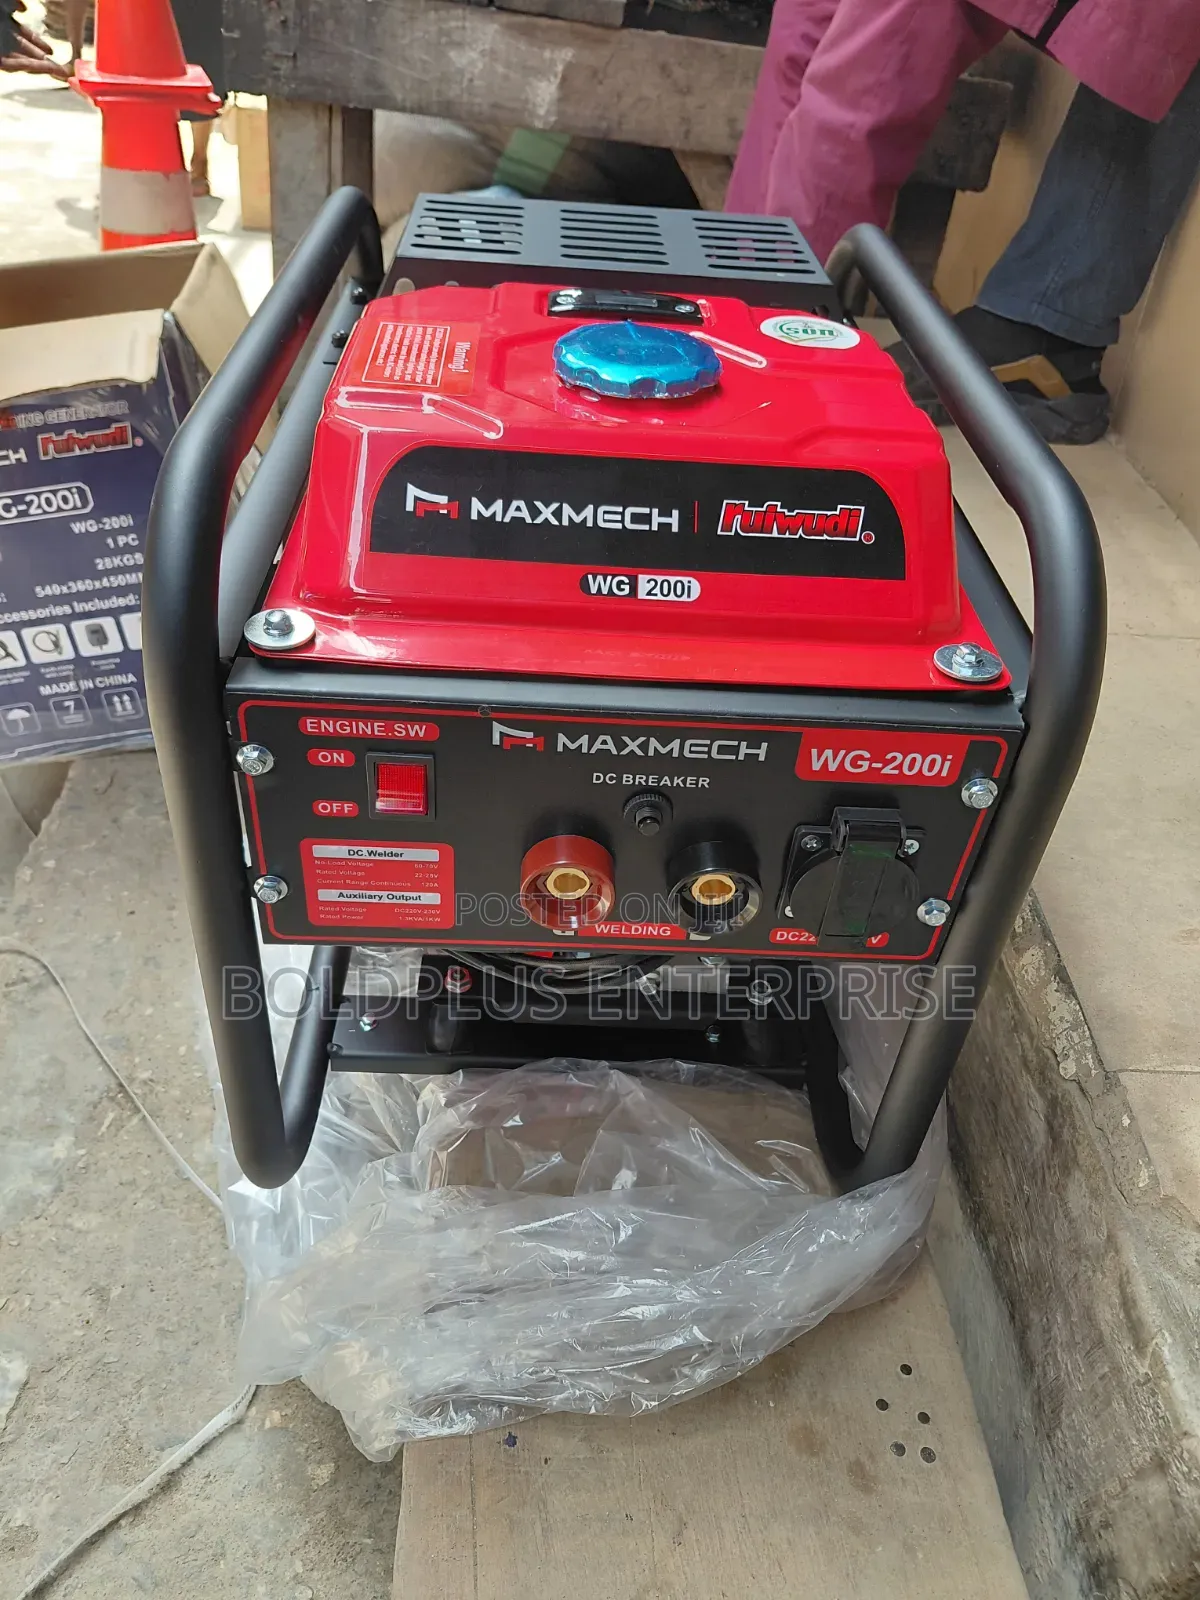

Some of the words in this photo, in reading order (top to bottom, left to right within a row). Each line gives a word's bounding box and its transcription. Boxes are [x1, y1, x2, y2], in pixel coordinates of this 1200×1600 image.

[471, 498, 679, 533] MAXMECH
[717, 499, 865, 539] ruiwudi
[105, 536, 115, 549] 1
[117, 534, 139, 547] PC
[586, 574, 631, 596] WG
[645, 576, 693, 600] 200i
[39, 681, 78, 696] MADE
[80, 679, 94, 690] IN
[96, 673, 137, 687] CHINA
[305, 718, 427, 738] ENGINE.SW
[556, 732, 769, 762] MAXMECH
[317, 751, 346, 764] ON
[810, 748, 954, 777] WG-200i
[592, 772, 617, 784] DC
[621, 774, 710, 788] BREAKER
[317, 802, 354, 814] OFF
[347, 848, 405, 859] DC.Welder
[337, 891, 384, 902] Auxiliary
[386, 893, 422, 903] Output
[594, 924, 671, 936] WELDING
